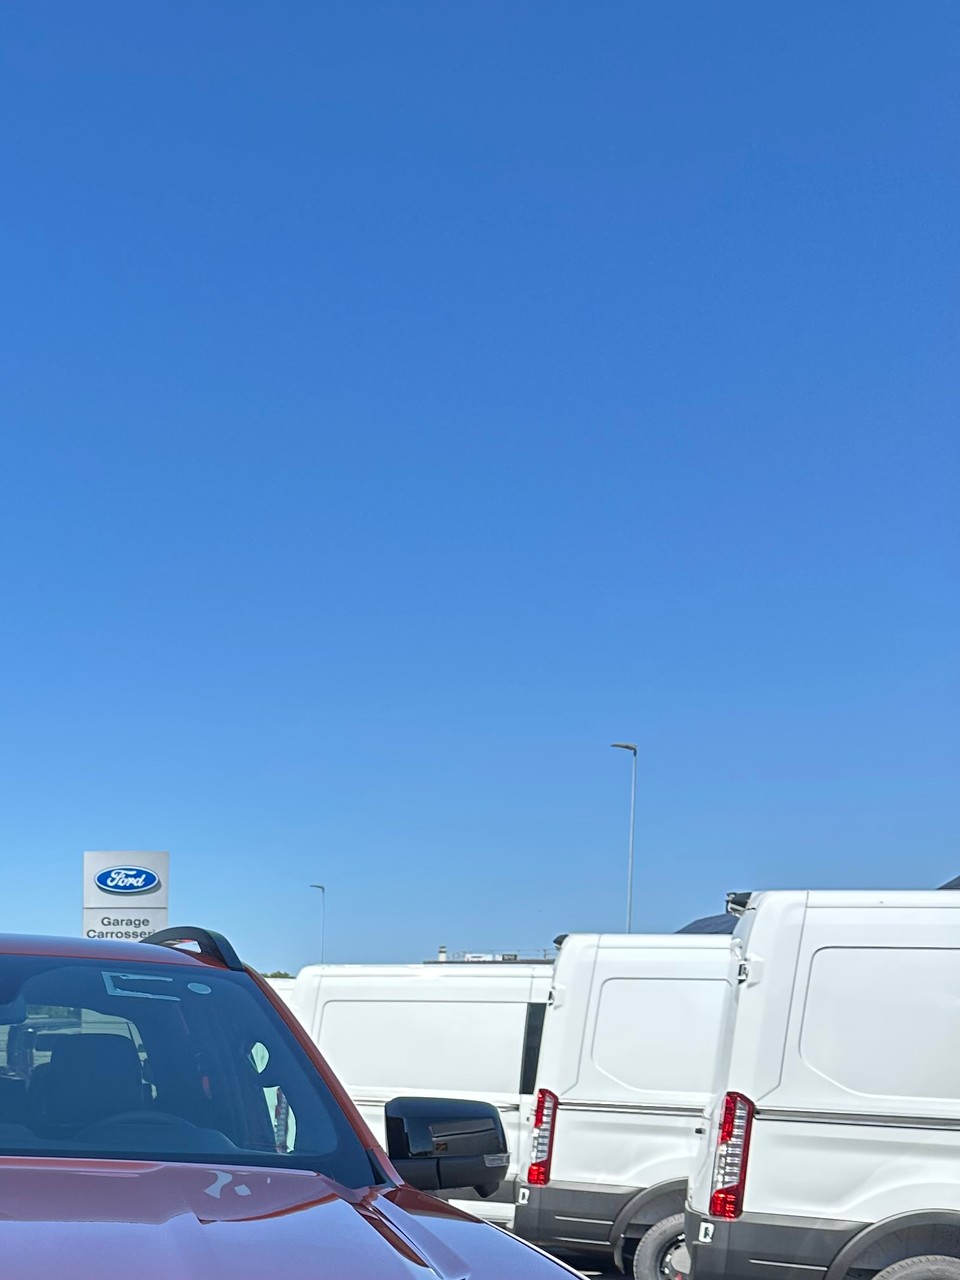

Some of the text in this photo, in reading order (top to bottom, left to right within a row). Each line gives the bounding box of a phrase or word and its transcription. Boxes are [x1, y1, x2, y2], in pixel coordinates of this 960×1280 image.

[106, 869, 147, 887] Ford
[101, 916, 150, 928] Garage
[86, 929, 156, 939] Carrosser
